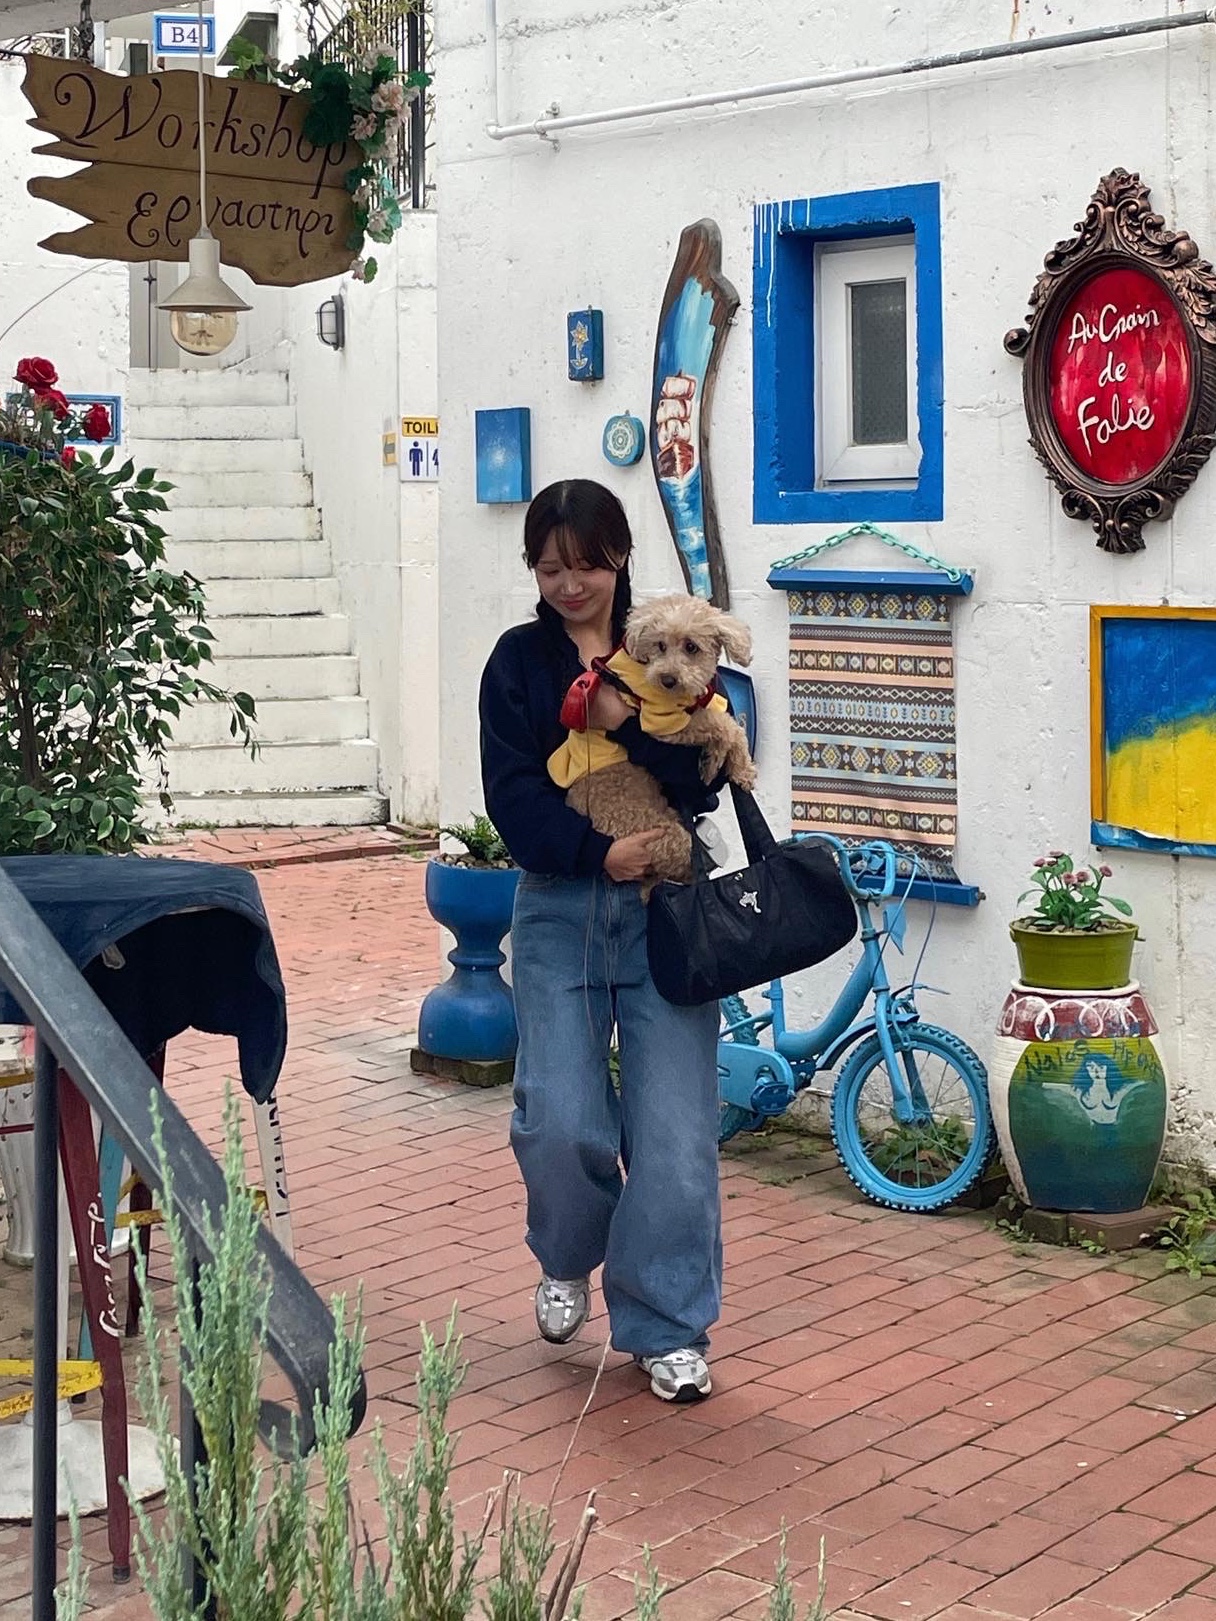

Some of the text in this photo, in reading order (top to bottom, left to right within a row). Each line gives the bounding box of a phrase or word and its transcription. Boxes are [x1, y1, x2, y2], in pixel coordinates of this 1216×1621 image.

[171, 26, 199, 43] B4
[1067, 312, 1098, 354] Au
[1098, 351, 1127, 387] de
